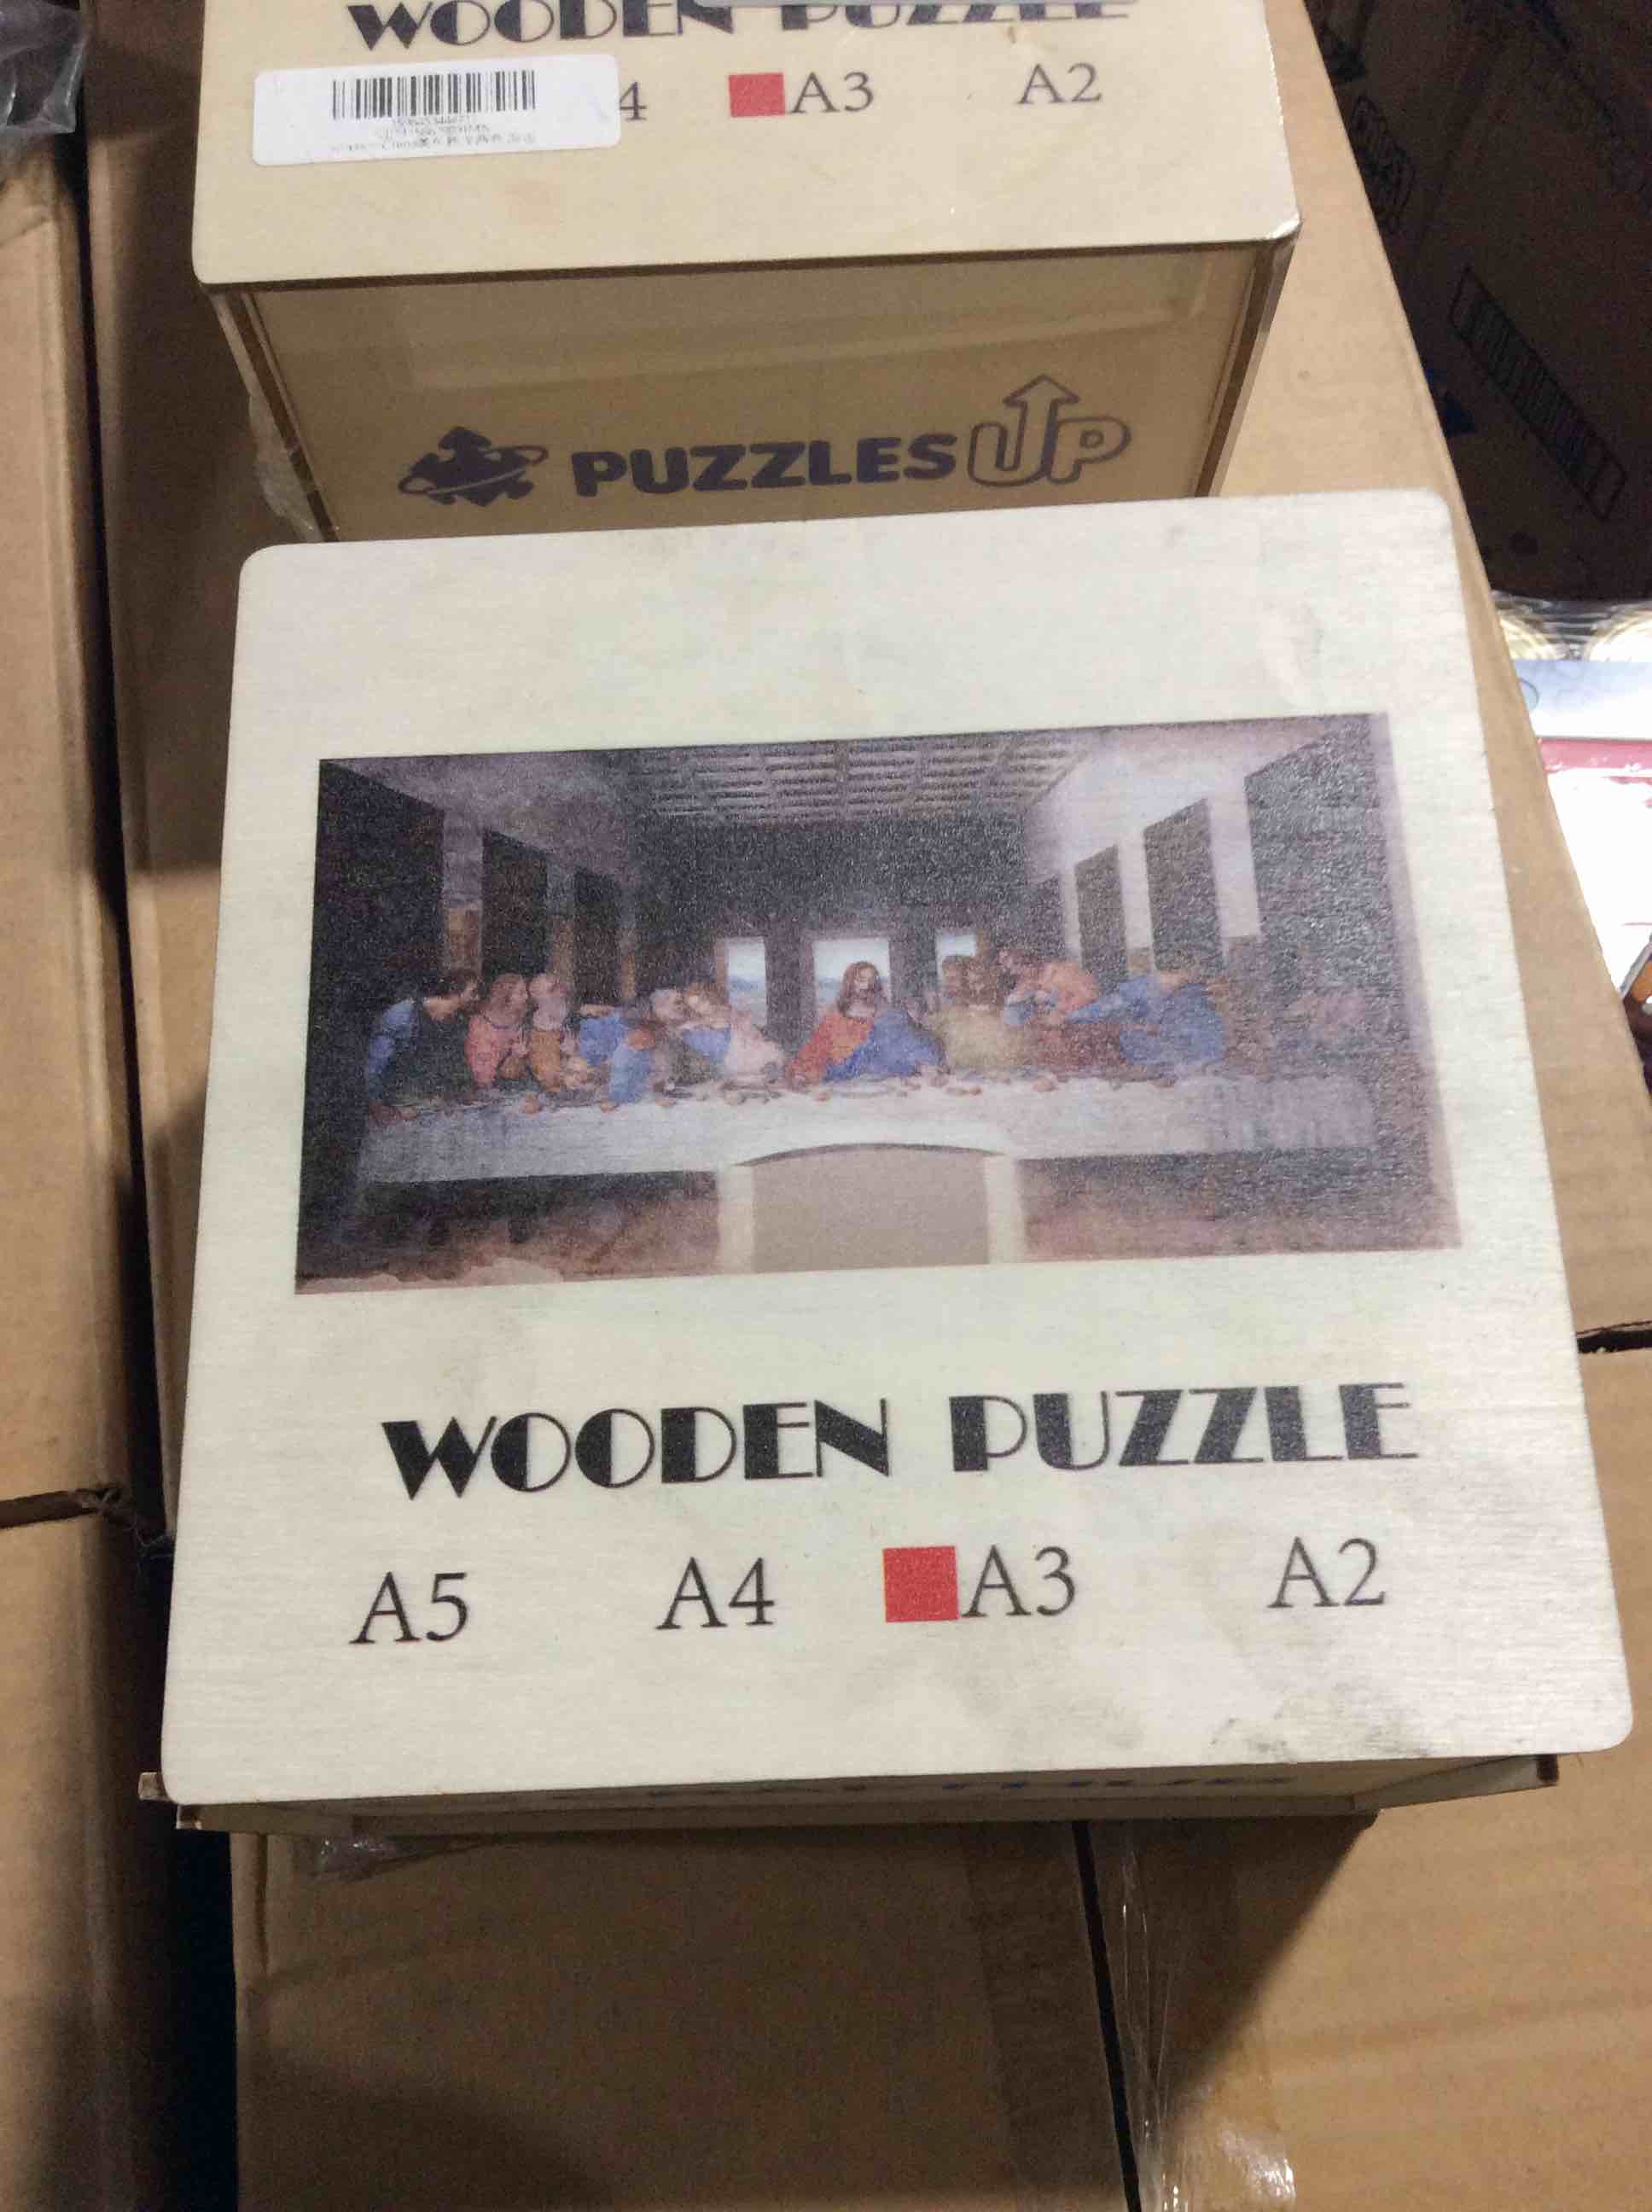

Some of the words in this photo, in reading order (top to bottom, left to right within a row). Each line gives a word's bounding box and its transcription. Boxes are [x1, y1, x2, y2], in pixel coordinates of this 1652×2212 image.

[346, 0, 735, 51] WOODEN
[618, 81, 647, 121] 4
[789, 72, 875, 114] A3
[1017, 63, 1102, 104] A2
[571, 434, 957, 498] PUZZLES
[967, 375, 1131, 487] UP
[381, 1397, 892, 1501] WOODEN
[949, 1382, 1419, 1472] PUZZLE
[349, 1571, 468, 1645] A5
[655, 1557, 776, 1631] A4
[961, 1545, 1076, 1619] A3
[1266, 1536, 1387, 1609] A2
